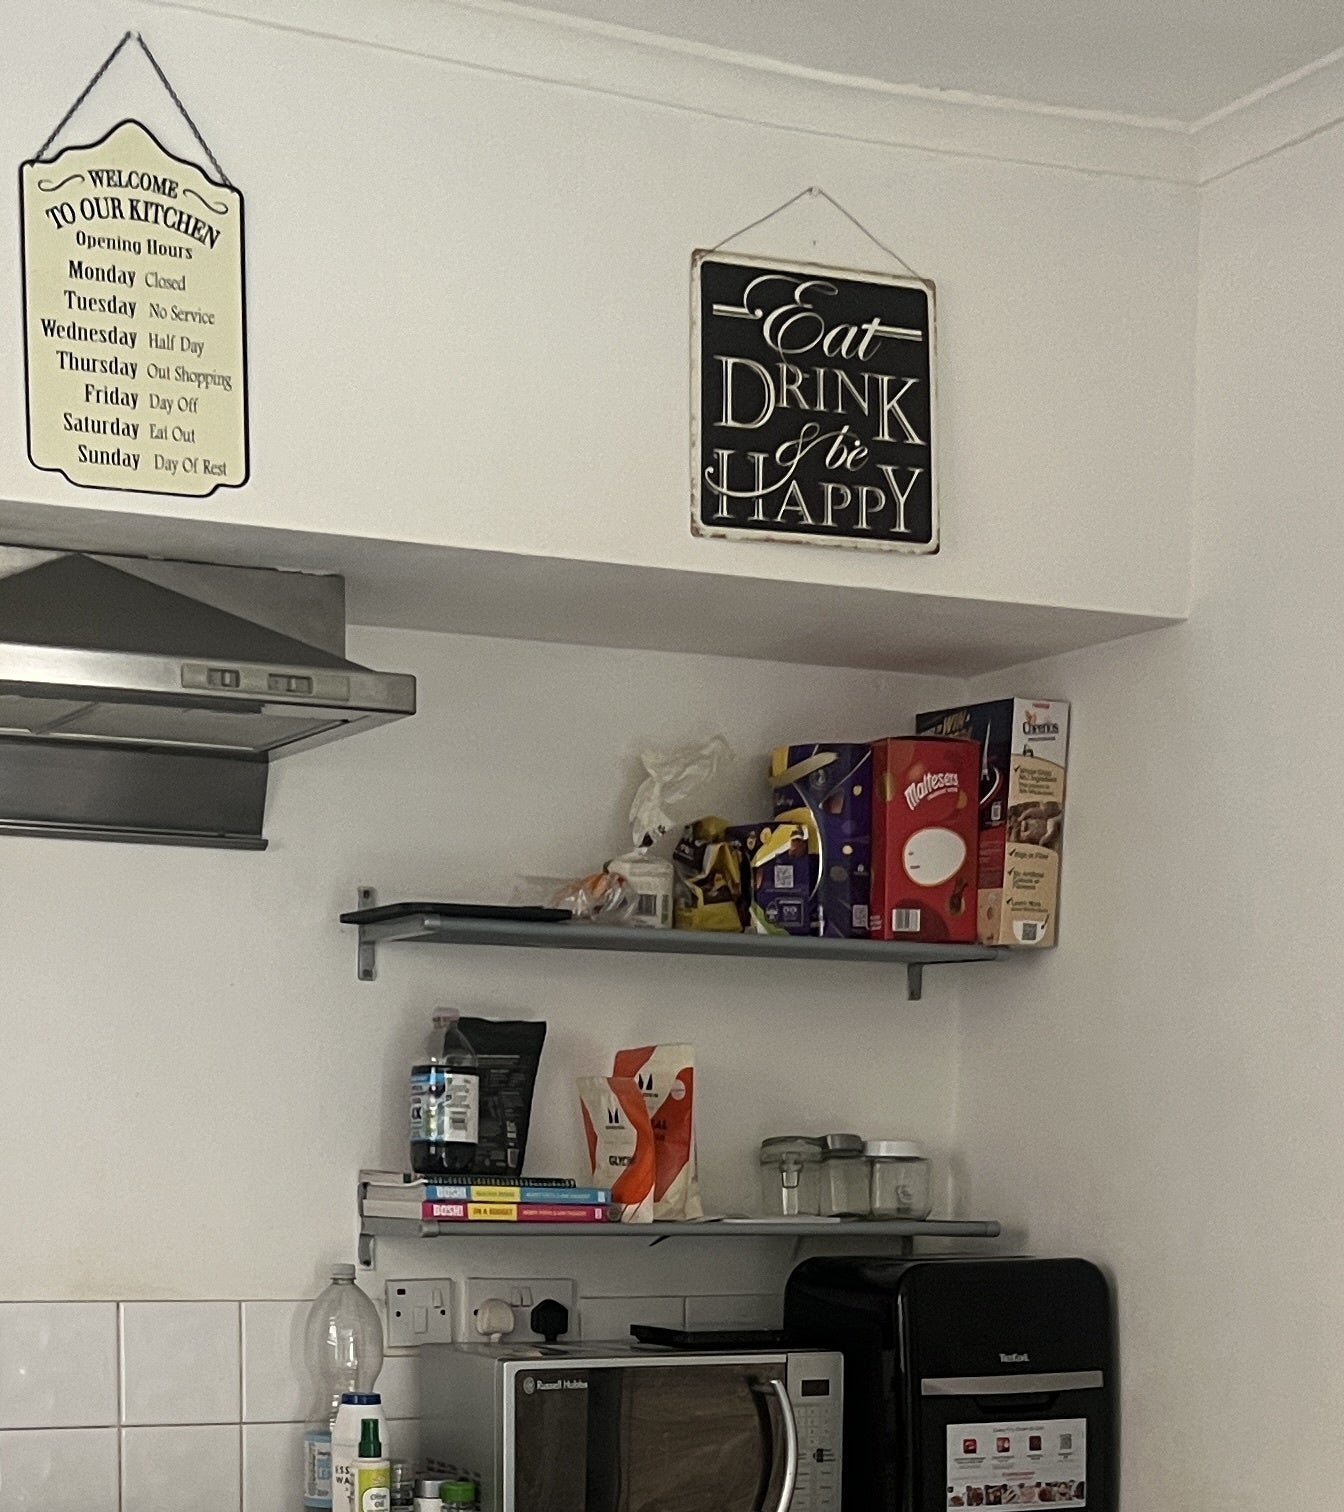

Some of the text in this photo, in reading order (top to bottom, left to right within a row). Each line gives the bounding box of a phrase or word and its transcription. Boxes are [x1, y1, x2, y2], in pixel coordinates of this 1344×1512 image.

[88, 169, 179, 200] WELCOME
[46, 196, 222, 250] TO OUR KITCHEN
[76, 230, 194, 260] Opening Hours
[68, 260, 187, 293] Monday Closed
[64, 289, 216, 326] Tuesday No Service
[744, 274, 882, 364] Eat
[41, 318, 205, 359] Wednesday Half Day
[56, 350, 233, 392] Thursday Out Shopping
[84, 383, 199, 416] Friday Day Off
[712, 354, 927, 446] DRINK
[63, 412, 196, 444] Saturday Eat Out
[78, 444, 141, 471] Sunday
[154, 454, 180, 477] Day
[203, 460, 227, 477] Rest
[824, 425, 869, 471] be
[711, 448, 924, 534] HAPPY
[904, 771, 959, 811] Maltesers
[998, 1353, 1030, 1363] Tefal
[536, 1379, 562, 1390] Russell
